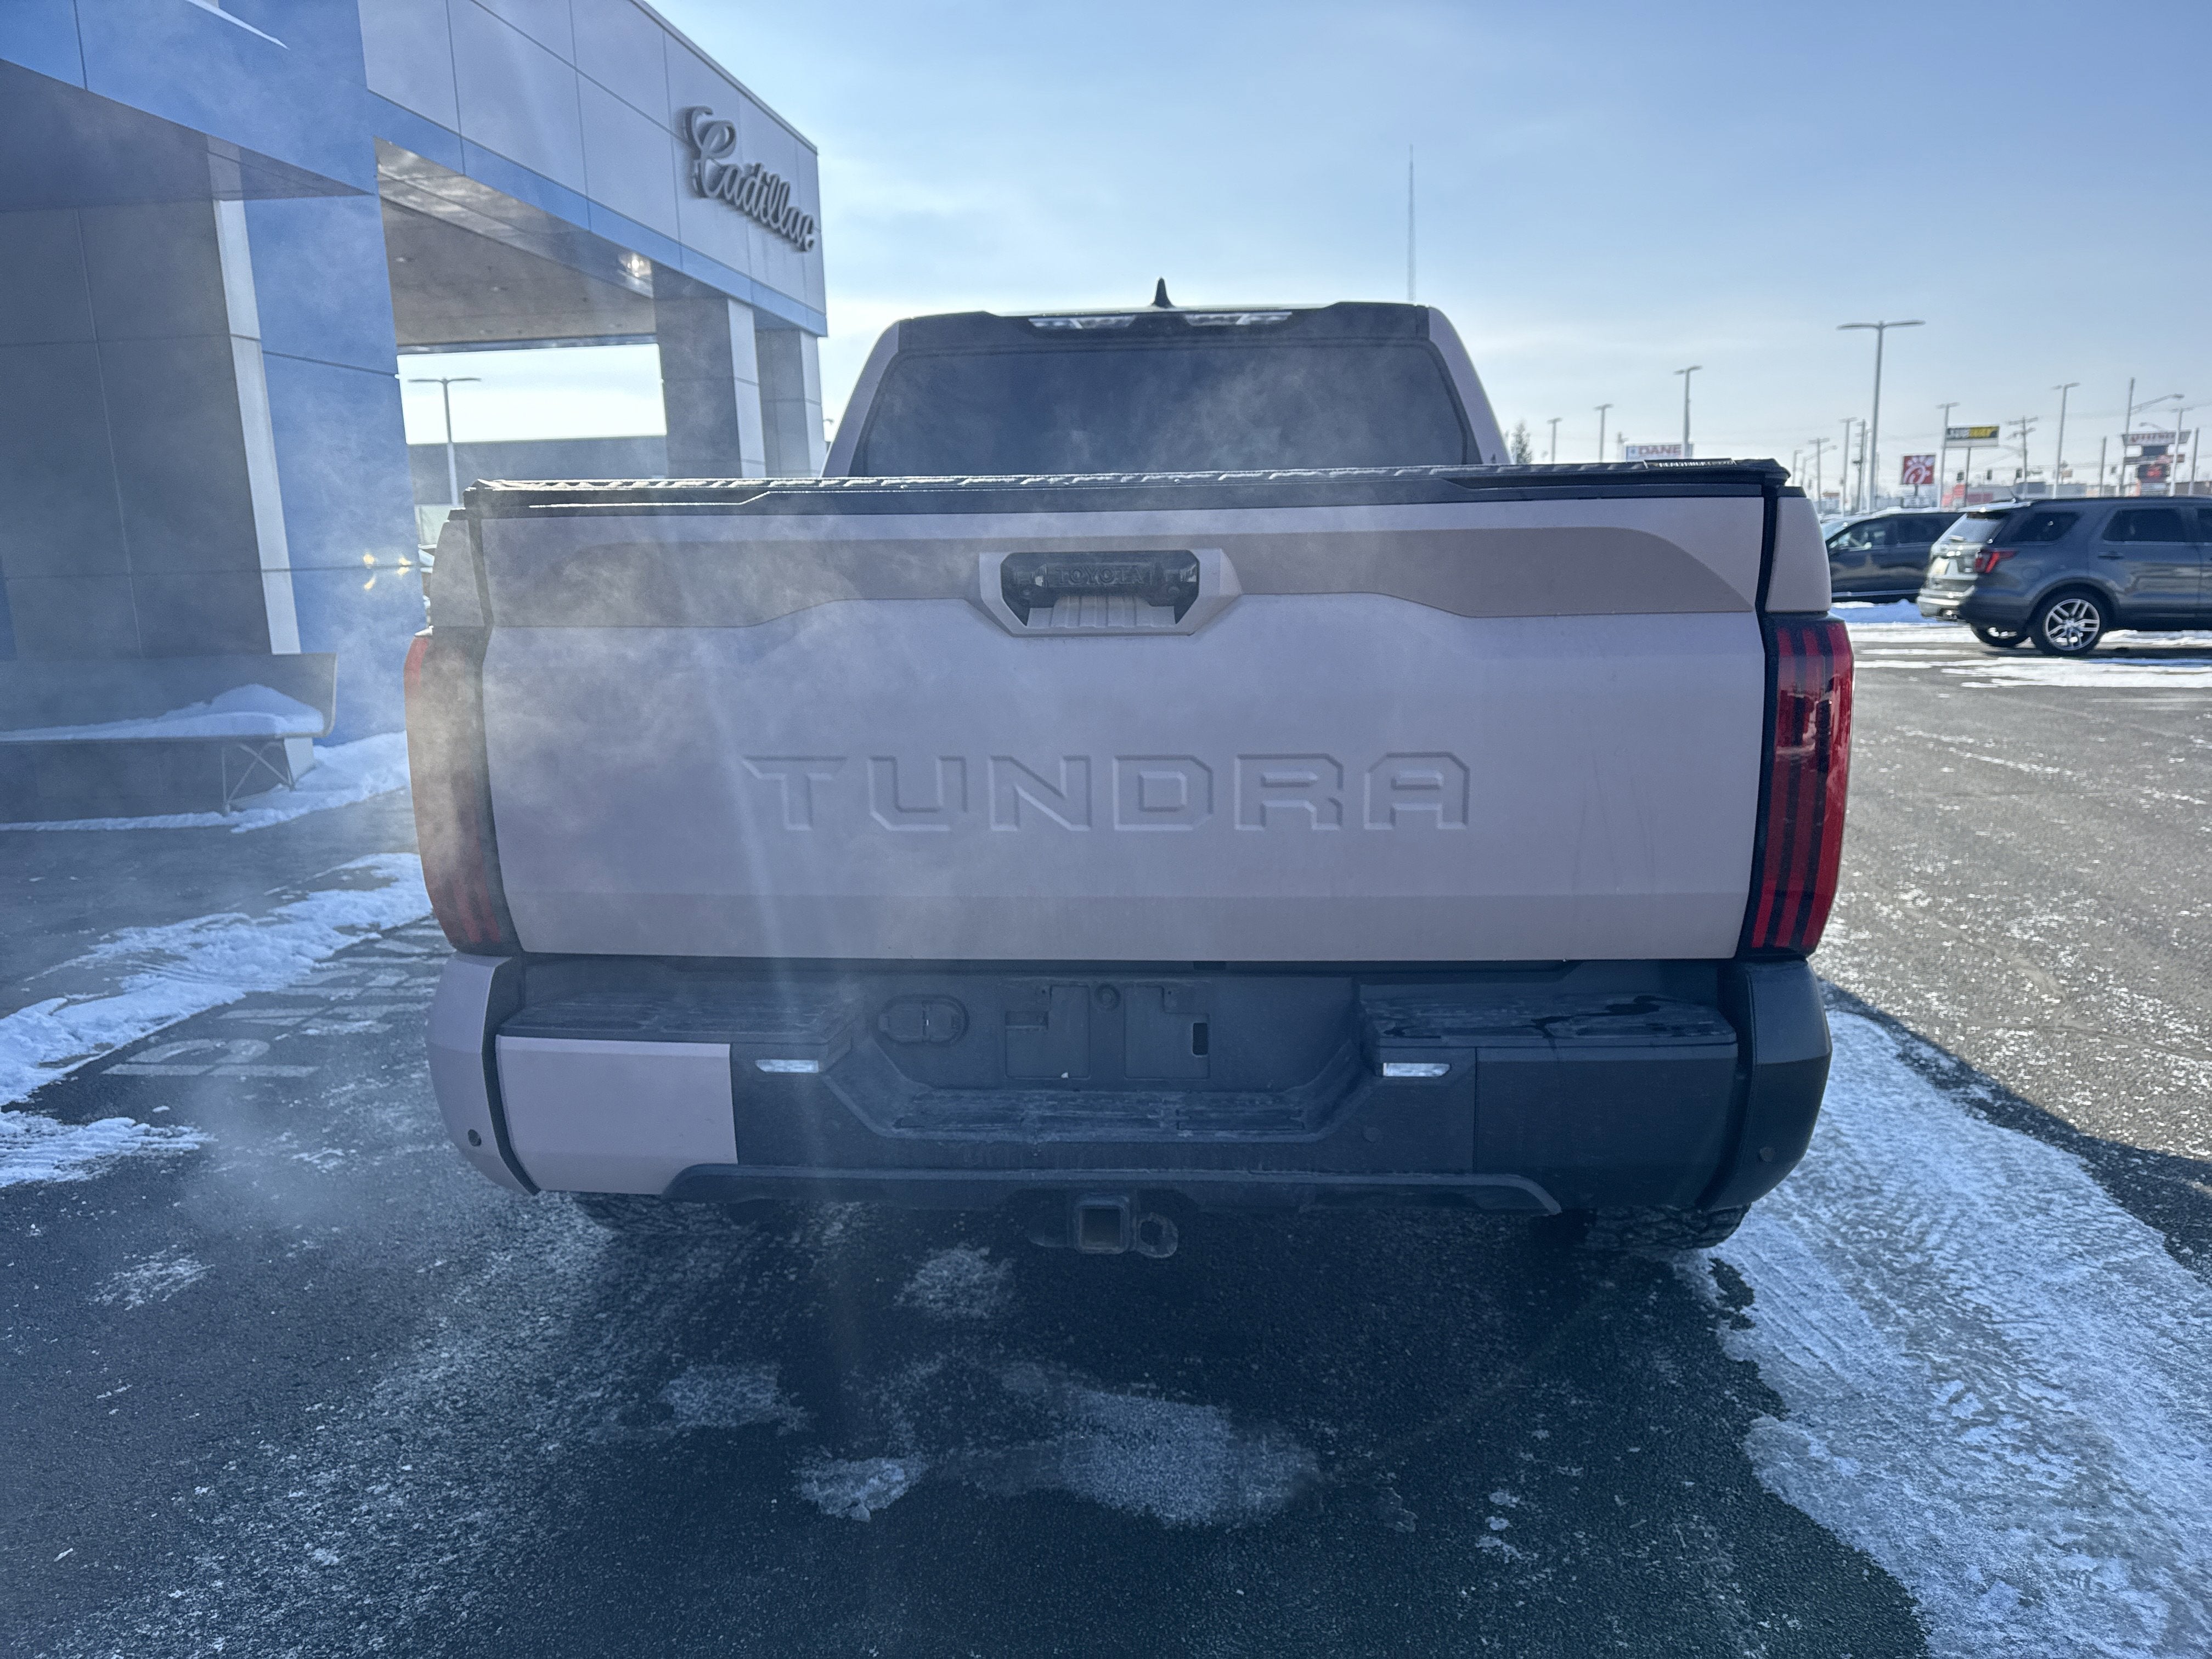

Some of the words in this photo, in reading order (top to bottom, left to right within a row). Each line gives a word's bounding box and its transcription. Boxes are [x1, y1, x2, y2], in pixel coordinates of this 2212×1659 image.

[685, 105, 815, 252] Cadillac
[1057, 565, 1144, 585] TOYOTA
[742, 752, 1470, 831] TUNDRA
